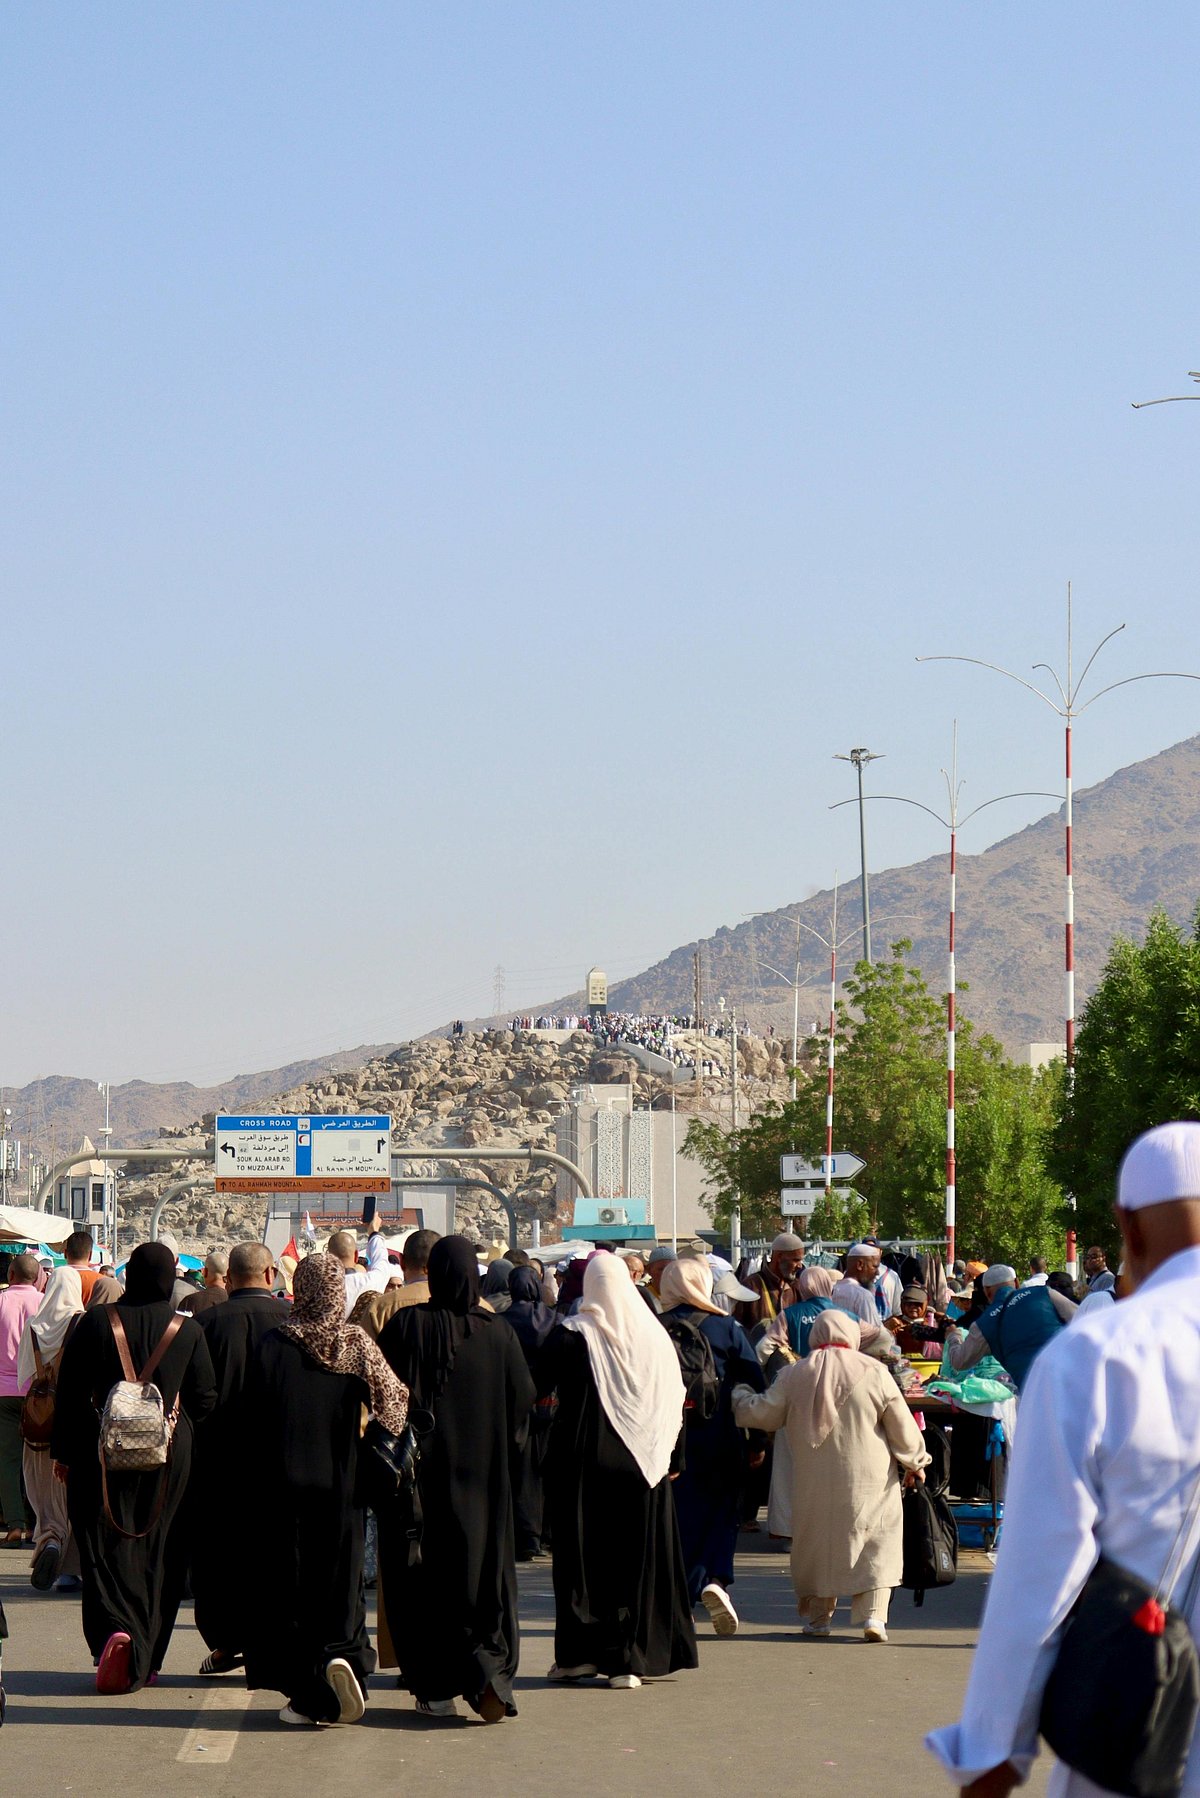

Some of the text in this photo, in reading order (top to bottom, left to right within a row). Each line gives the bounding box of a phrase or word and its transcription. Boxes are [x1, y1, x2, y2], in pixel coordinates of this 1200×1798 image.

[352, 1120, 377, 1128] الطريق
[273, 1133, 289, 1141] طريق
[253, 1144, 288, 1152] إلى مزدلفة
[365, 1181, 376, 1190] إلى
